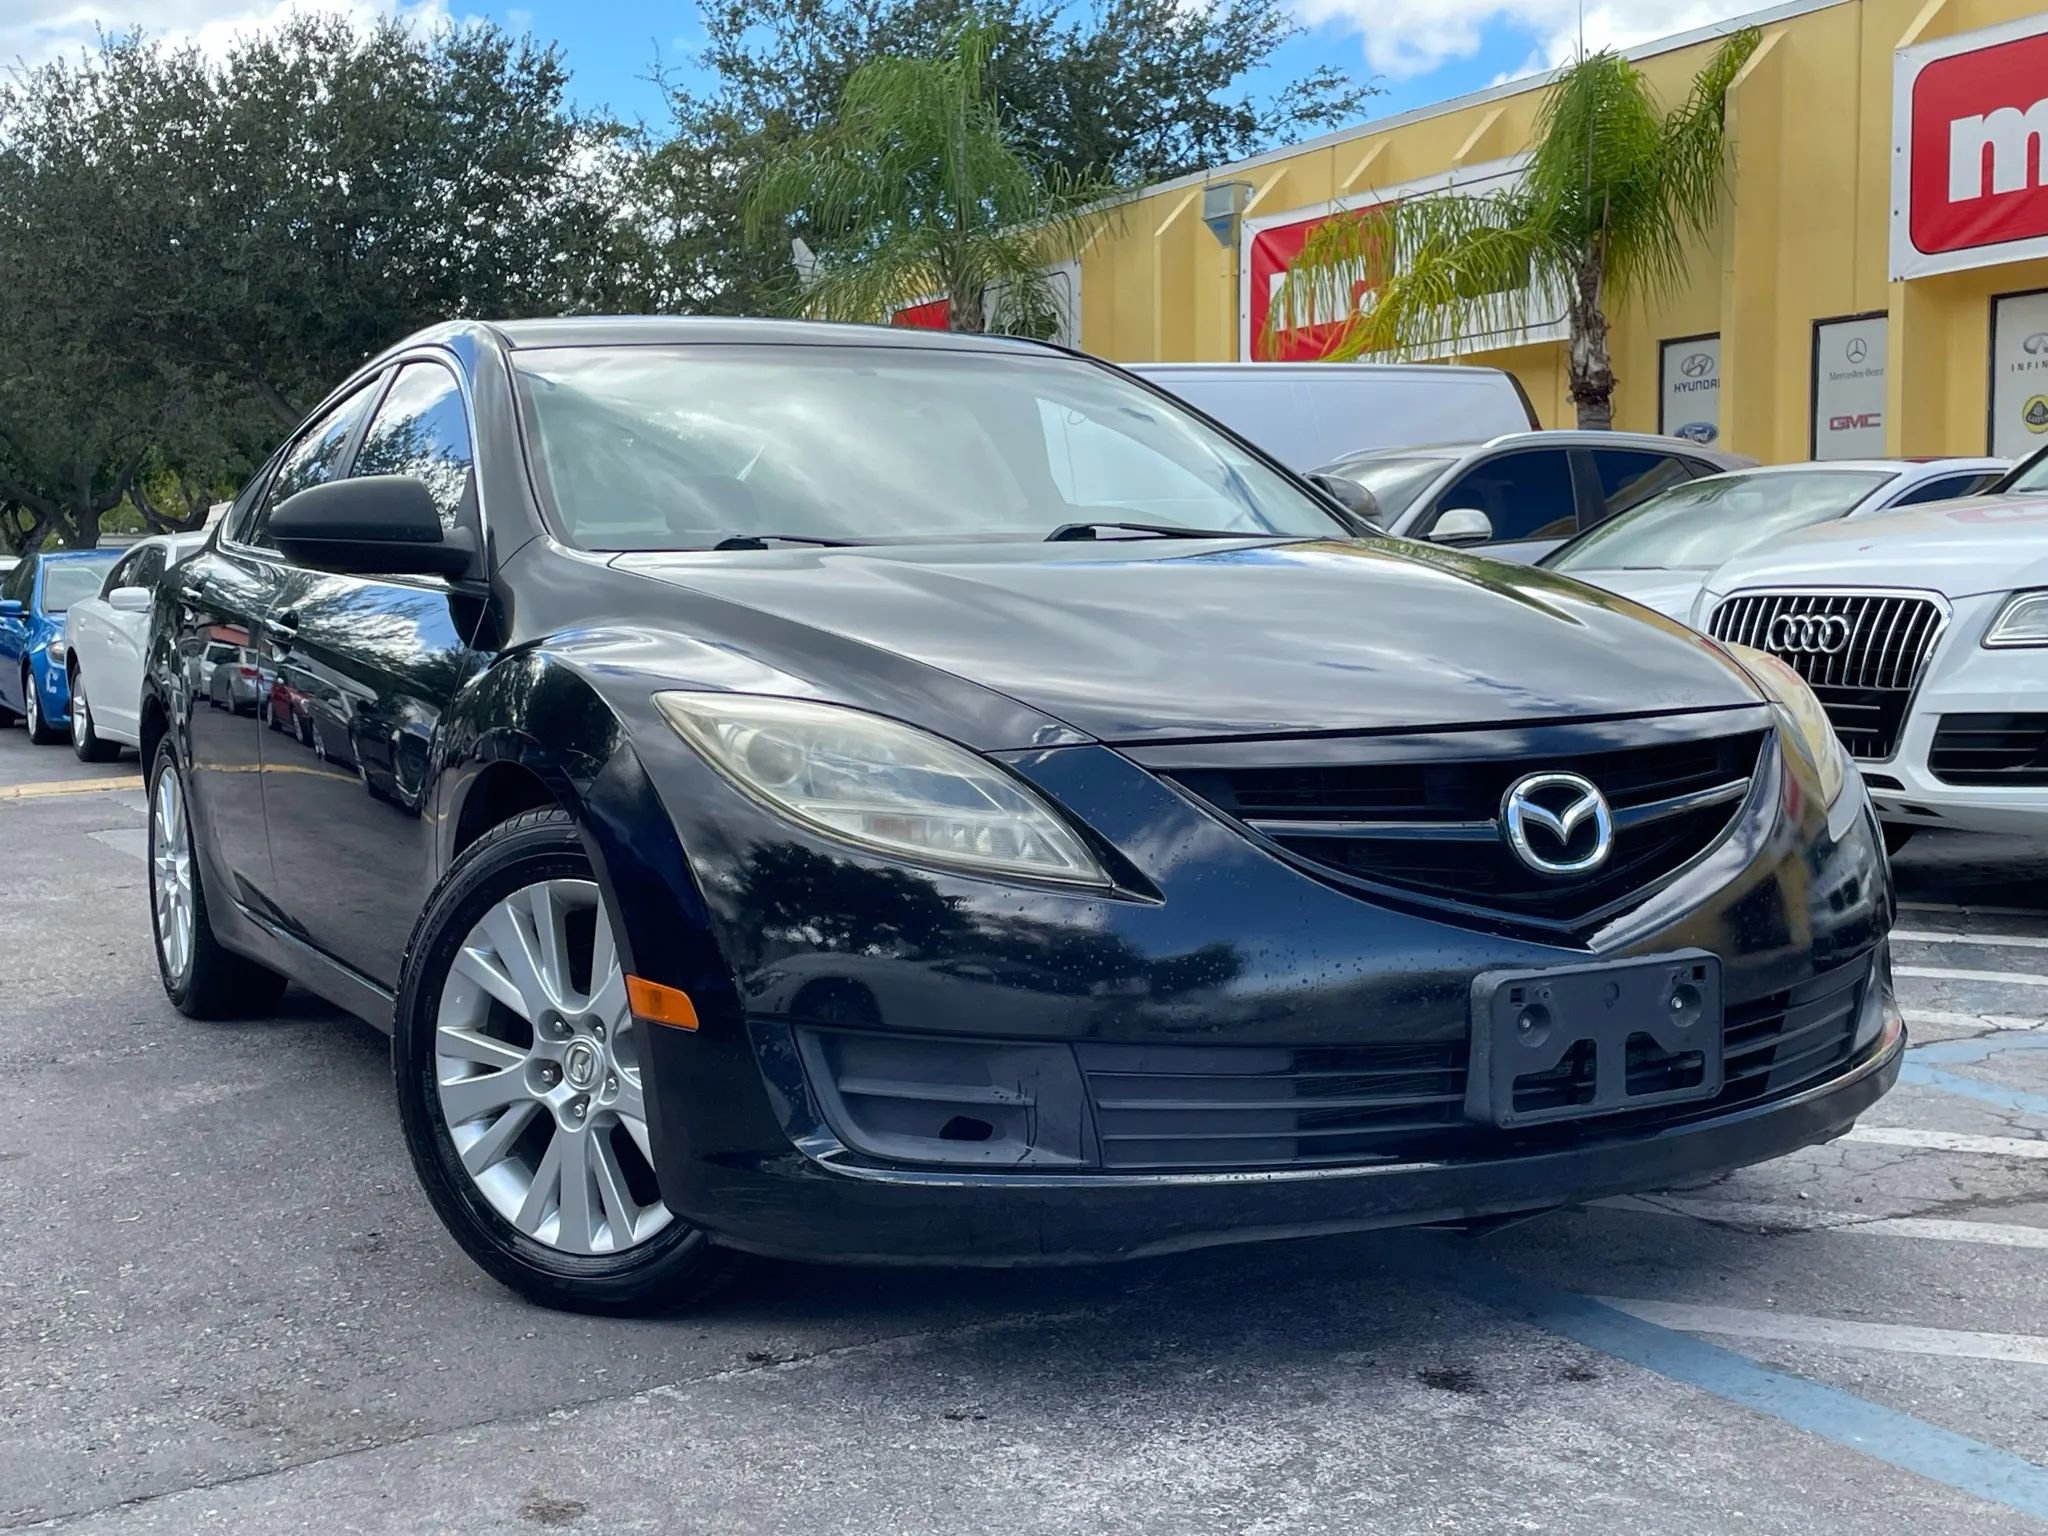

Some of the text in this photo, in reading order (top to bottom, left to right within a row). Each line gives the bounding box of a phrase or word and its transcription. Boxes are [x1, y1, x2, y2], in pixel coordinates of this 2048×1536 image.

[1829, 367, 1884, 381] Mercedes-Benz
[1673, 377, 1721, 393] HYUNDAI
[1829, 412, 1881, 431] GMC
[1683, 426, 1711, 441] Ford
